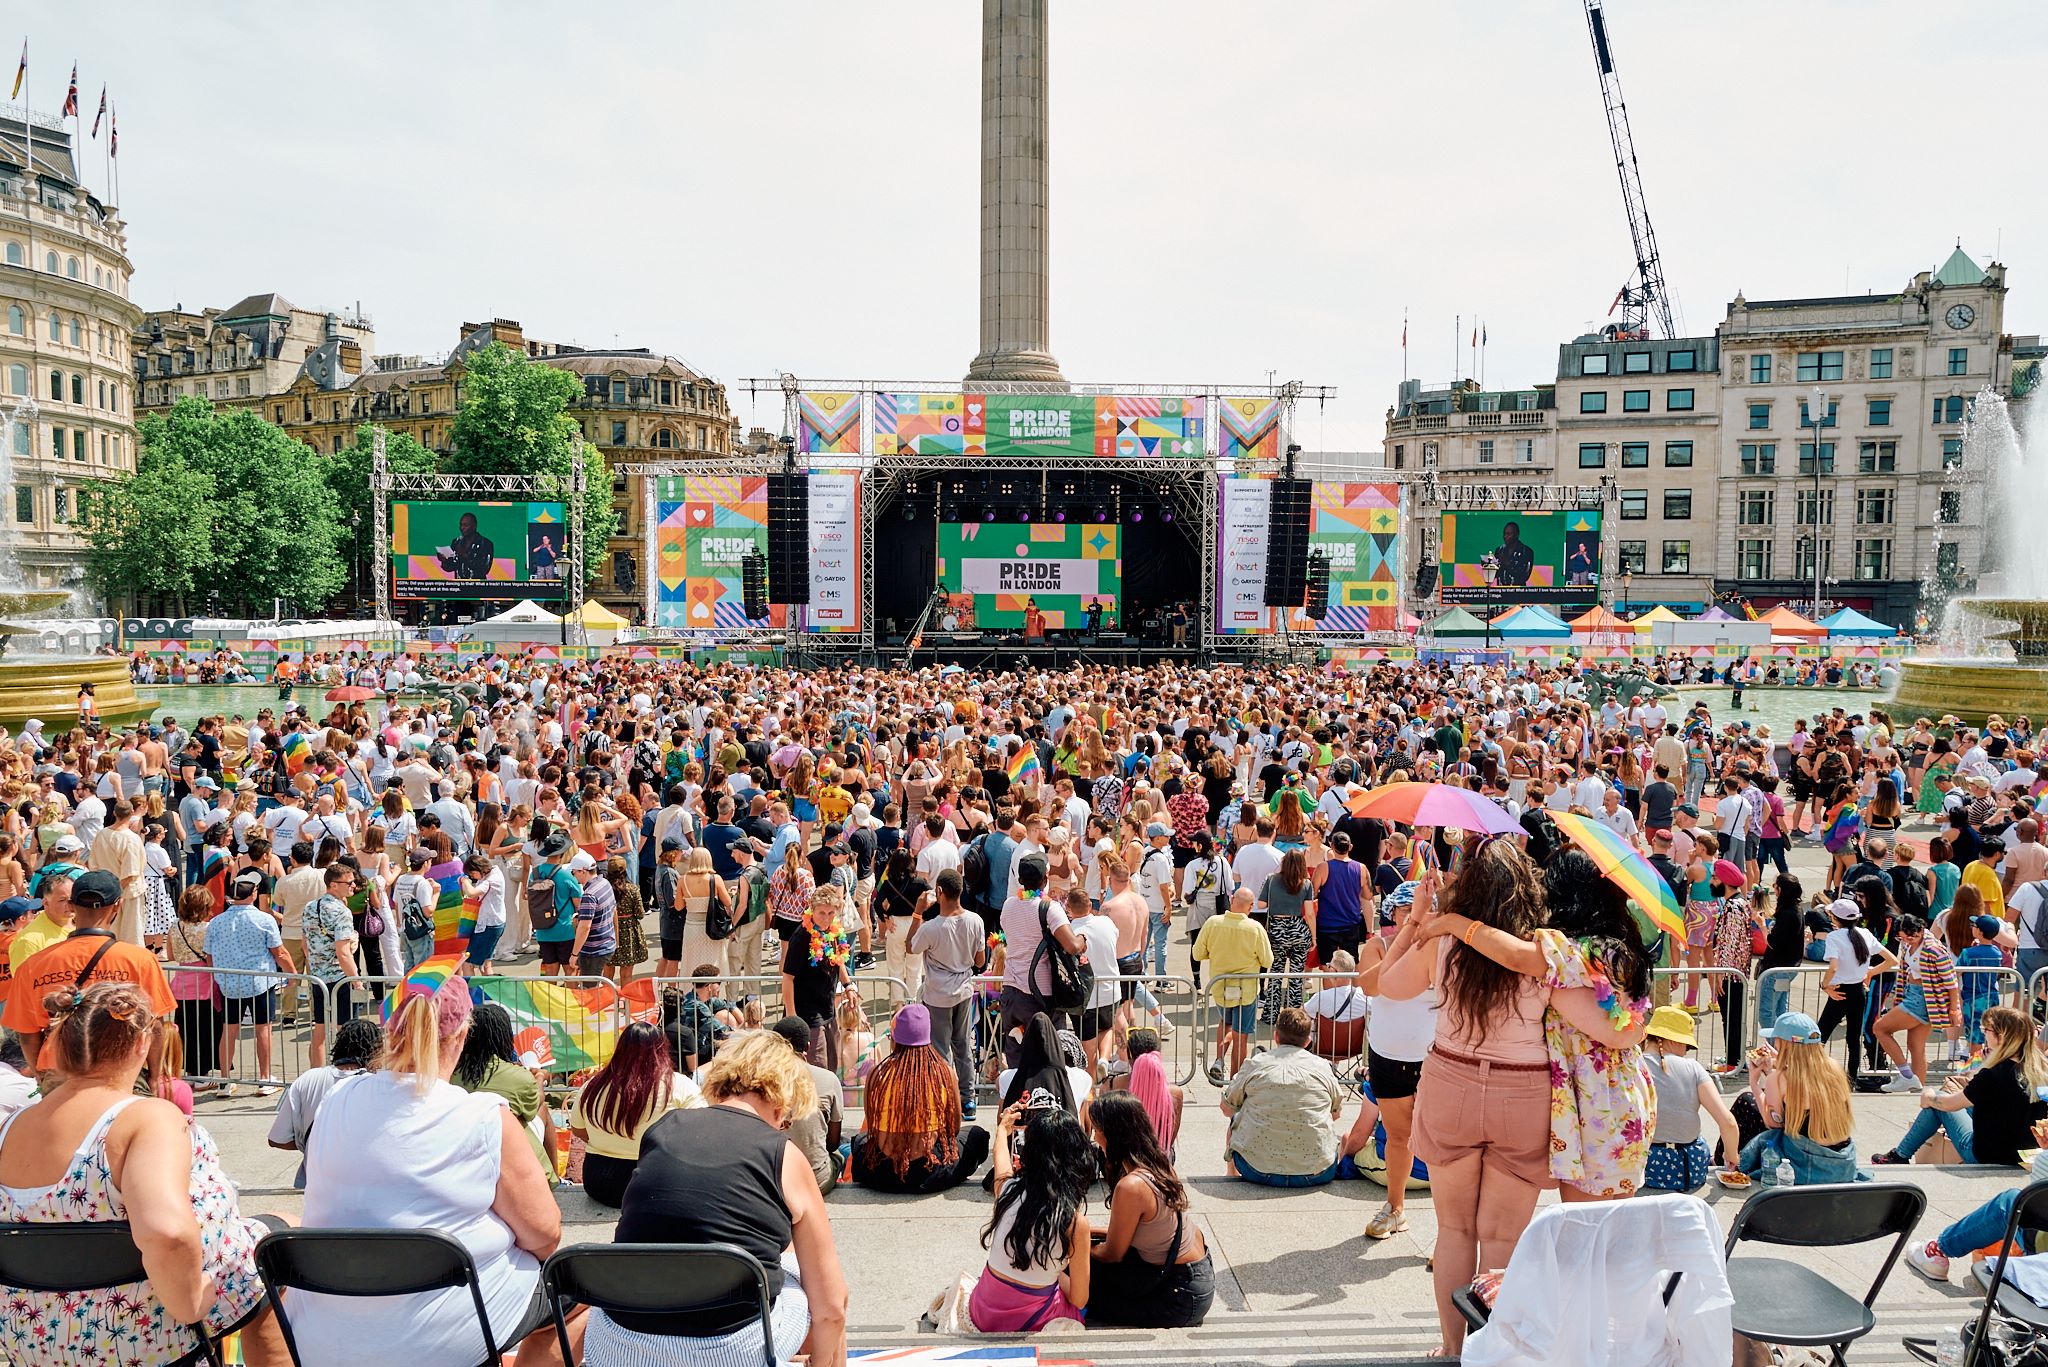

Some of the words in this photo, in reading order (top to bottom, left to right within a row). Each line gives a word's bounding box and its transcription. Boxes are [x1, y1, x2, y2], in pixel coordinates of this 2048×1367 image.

[1010, 427, 1022, 437] IN
[1024, 427, 1071, 437] LONDON
[702, 553, 712, 561] IN
[714, 553, 753, 562] LOND
[1000, 581, 1011, 589] IN
[1015, 581, 1061, 590] LONDON
[1811, 600, 1834, 608] MNGER
[33, 971, 72, 989] ACCESS
[75, 970, 129, 982] SEWARD
